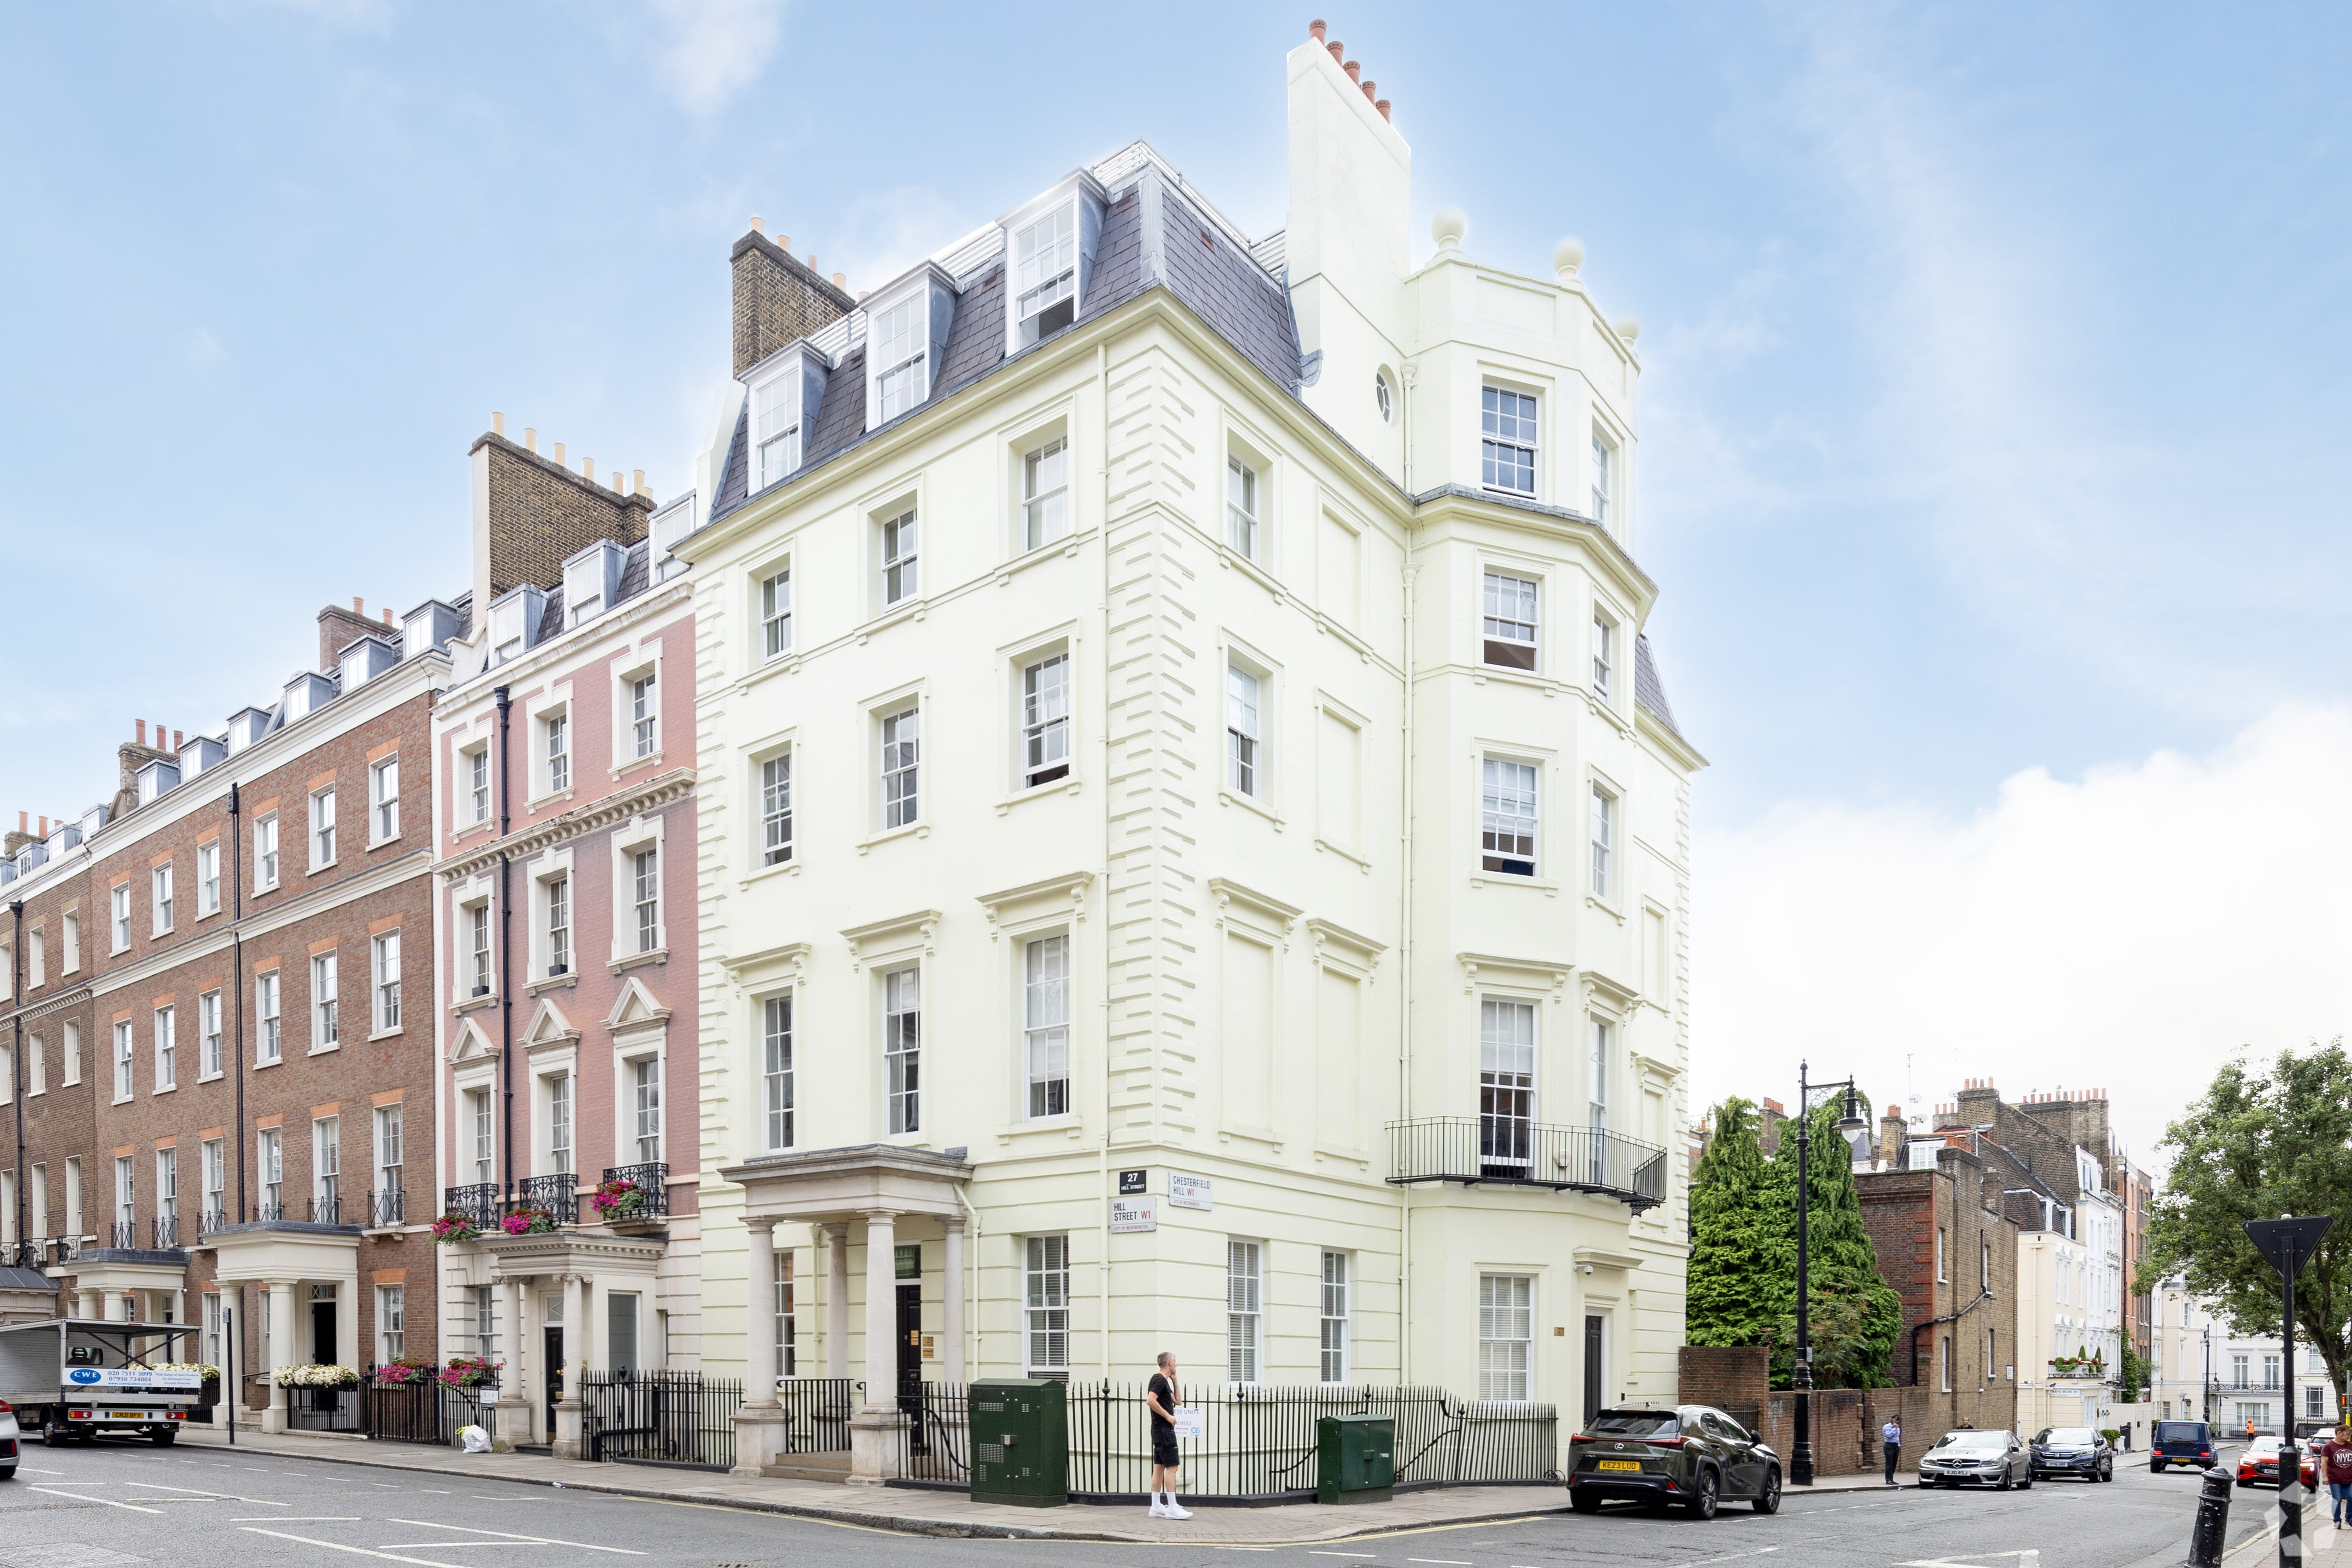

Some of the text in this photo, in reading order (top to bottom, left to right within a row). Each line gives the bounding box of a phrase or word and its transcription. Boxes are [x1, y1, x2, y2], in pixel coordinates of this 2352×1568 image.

[1127, 1173, 1138, 1182] 27
[1173, 1176, 1210, 1189] CHESTERFIELD
[1173, 1186, 1194, 1197] HILL W1
[1114, 1202, 1126, 1211] HILL
[1114, 1210, 1151, 1221] STREET W1
[2336, 1453, 2352, 1463] NYC
